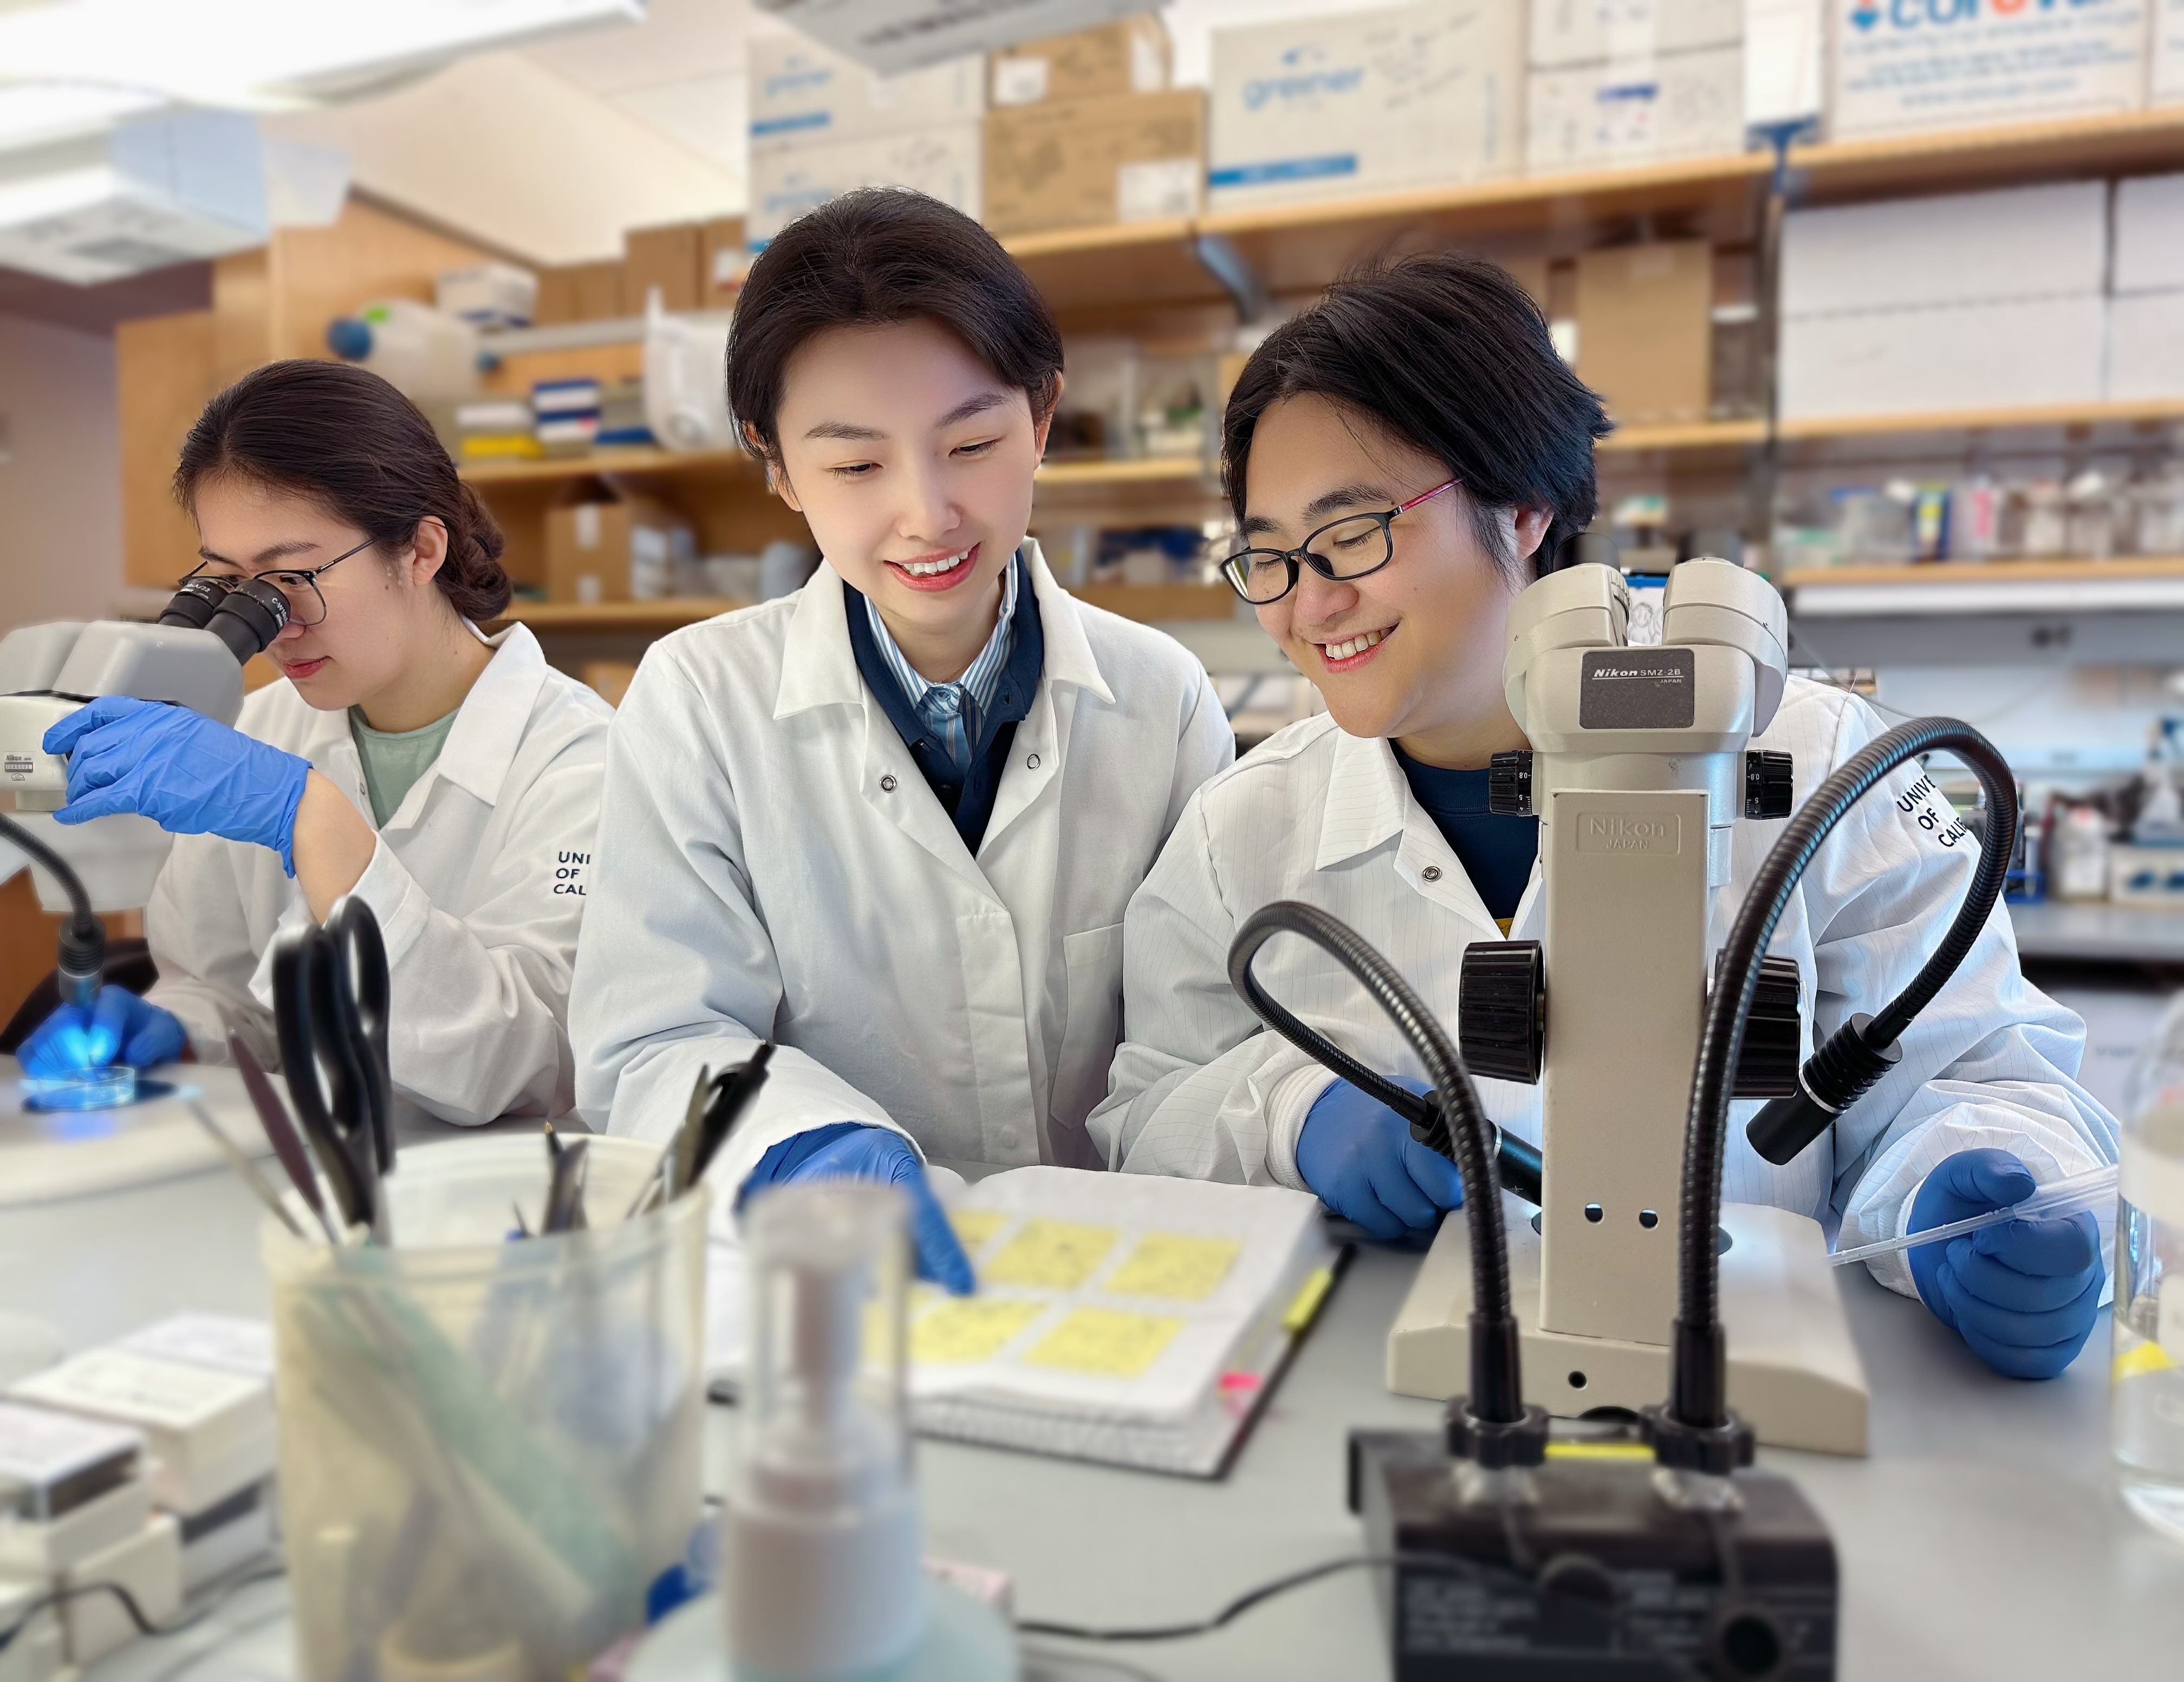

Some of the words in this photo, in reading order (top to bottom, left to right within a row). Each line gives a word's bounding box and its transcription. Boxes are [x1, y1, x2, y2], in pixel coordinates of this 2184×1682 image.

[1594, 668, 1638, 677] Nikon
[1918, 808, 1939, 830] OF
[1590, 819, 1666, 837] Nikon
[1606, 839, 1648, 849] JAPAN
[558, 851, 591, 865] UNI
[556, 868, 580, 879] OF
[554, 884, 587, 896] CAL
